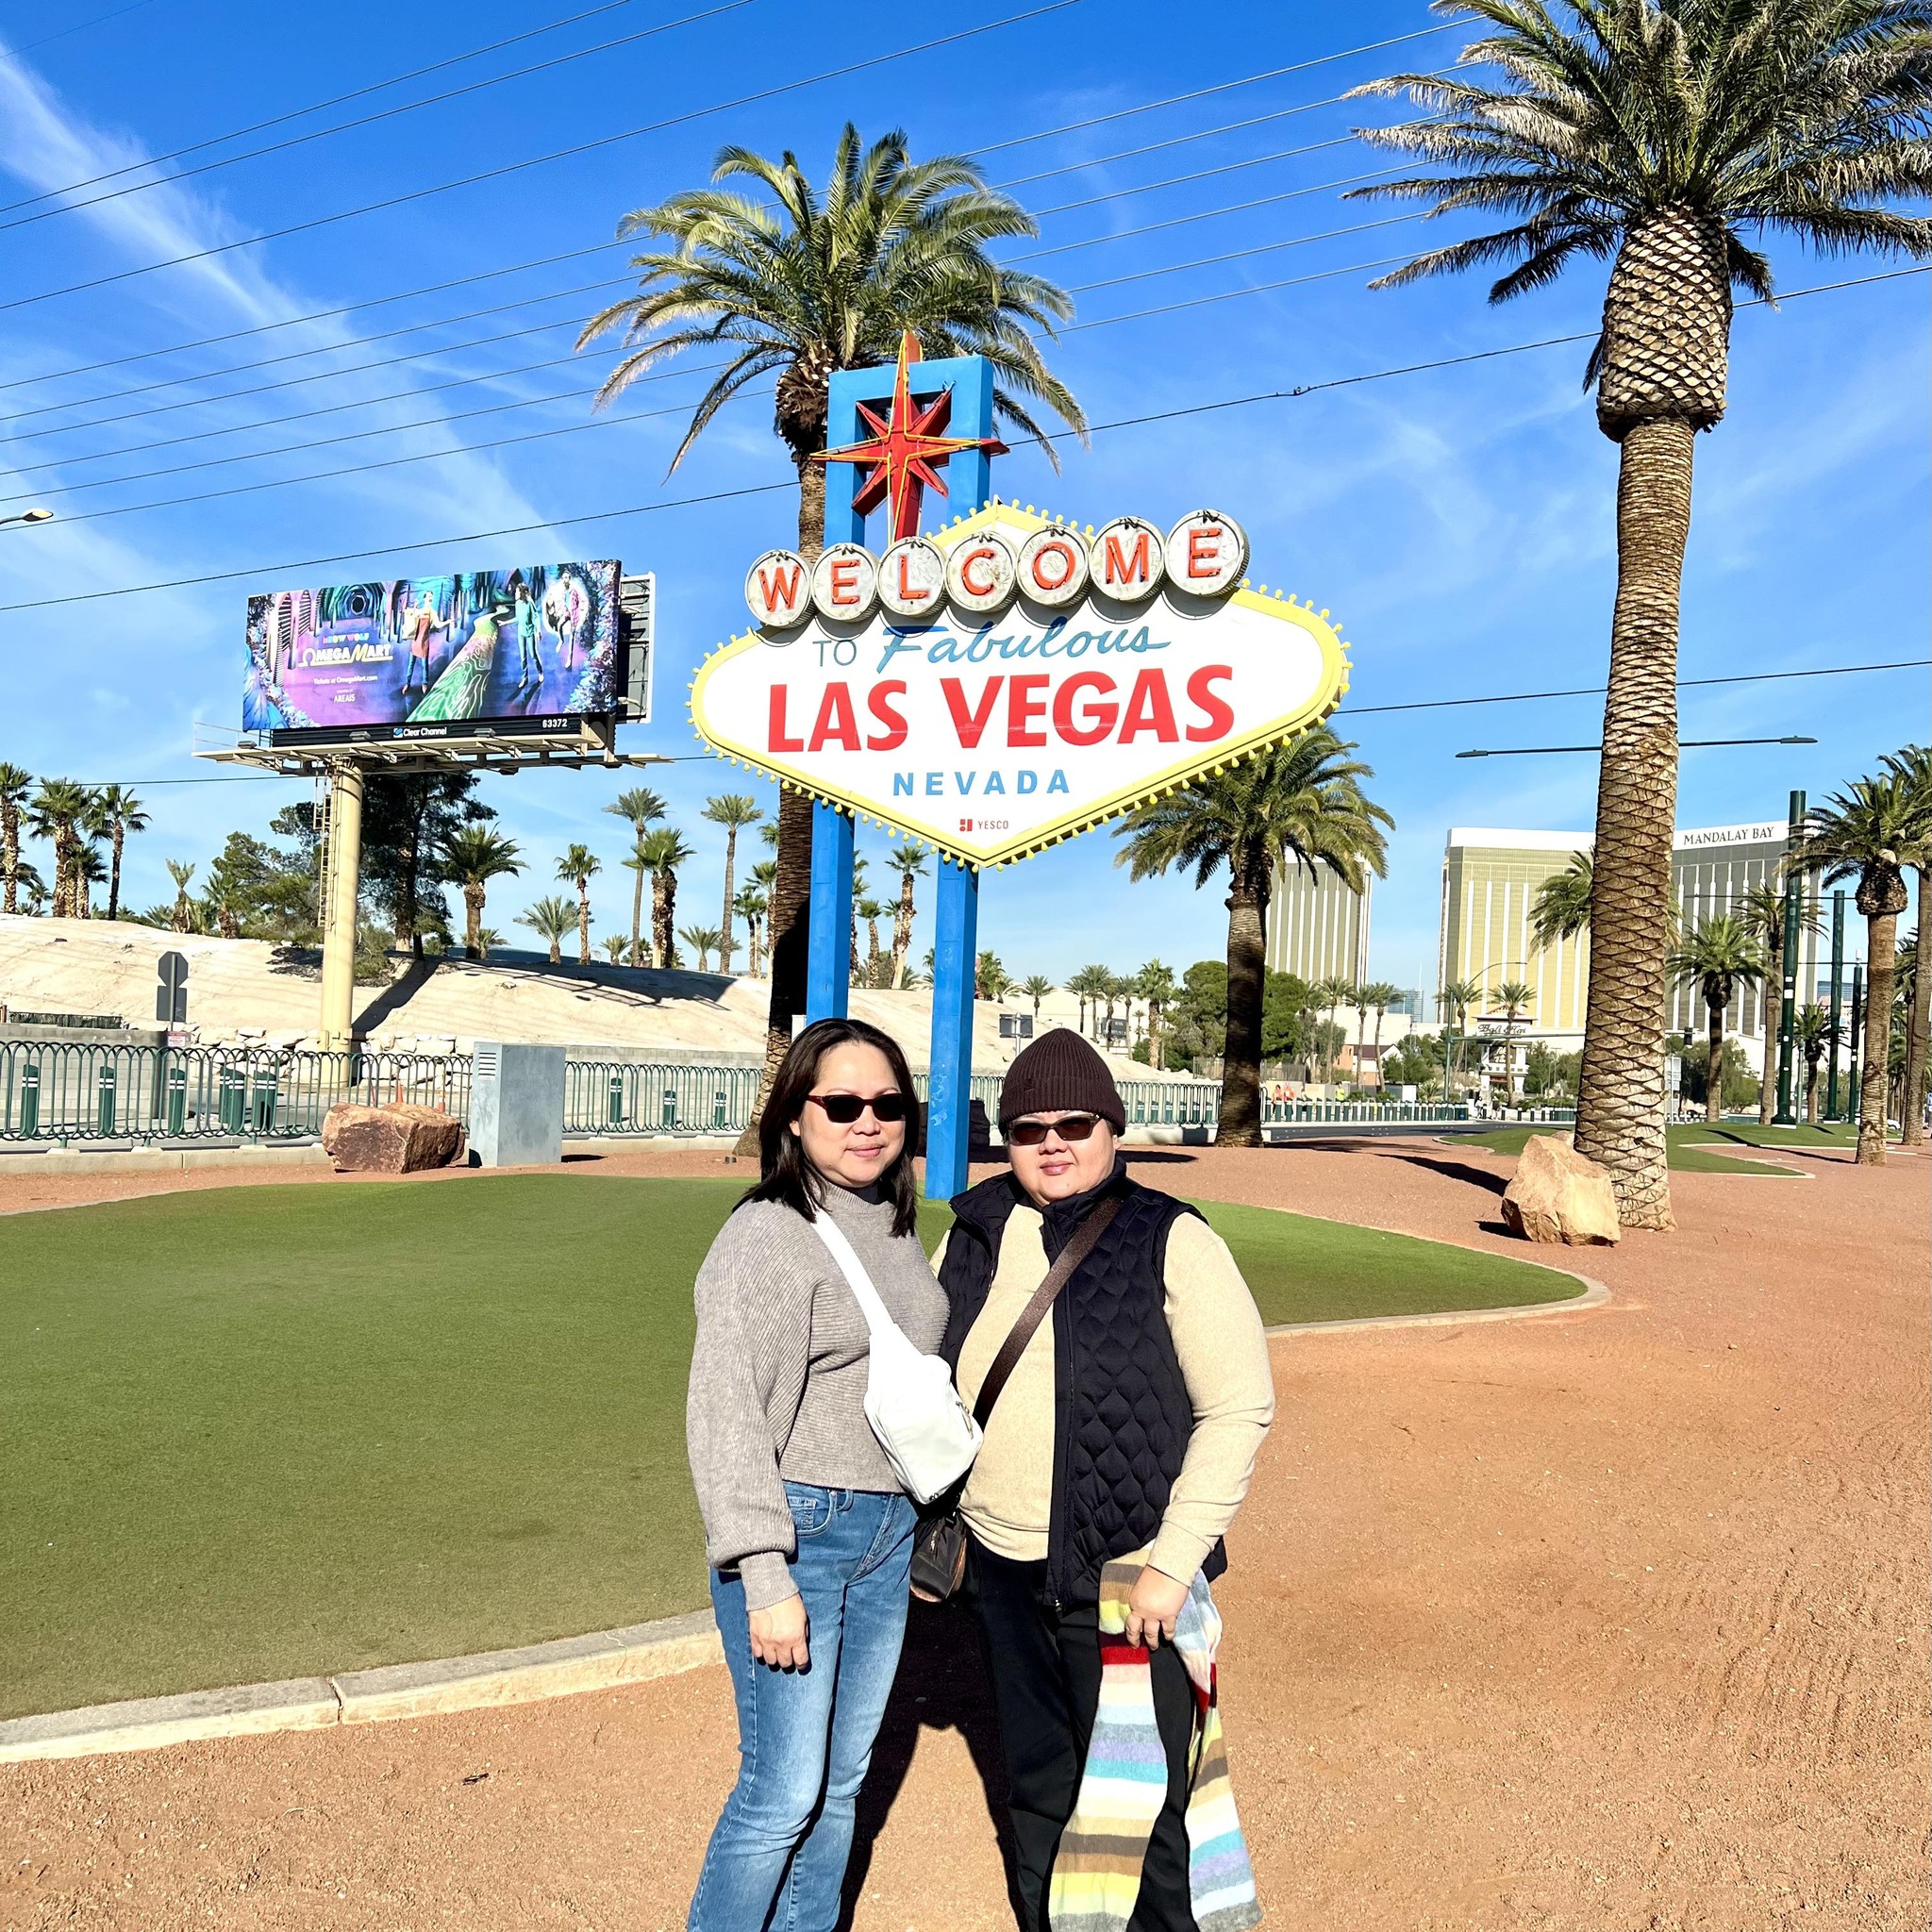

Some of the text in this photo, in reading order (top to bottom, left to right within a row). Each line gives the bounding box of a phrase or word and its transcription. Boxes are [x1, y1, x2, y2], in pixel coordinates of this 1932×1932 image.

[758, 526, 1223, 612] WELCOME
[812, 616, 1171, 674] TO Fabulous
[768, 664, 1235, 753] LAS VEGAS
[404, 727, 447, 738] Clear Channel
[542, 719, 567, 728] 63372
[892, 769, 1070, 796] NEVADA
[977, 820, 1008, 829] YESCO
[1684, 826, 1774, 845] MANDALAY BAY
